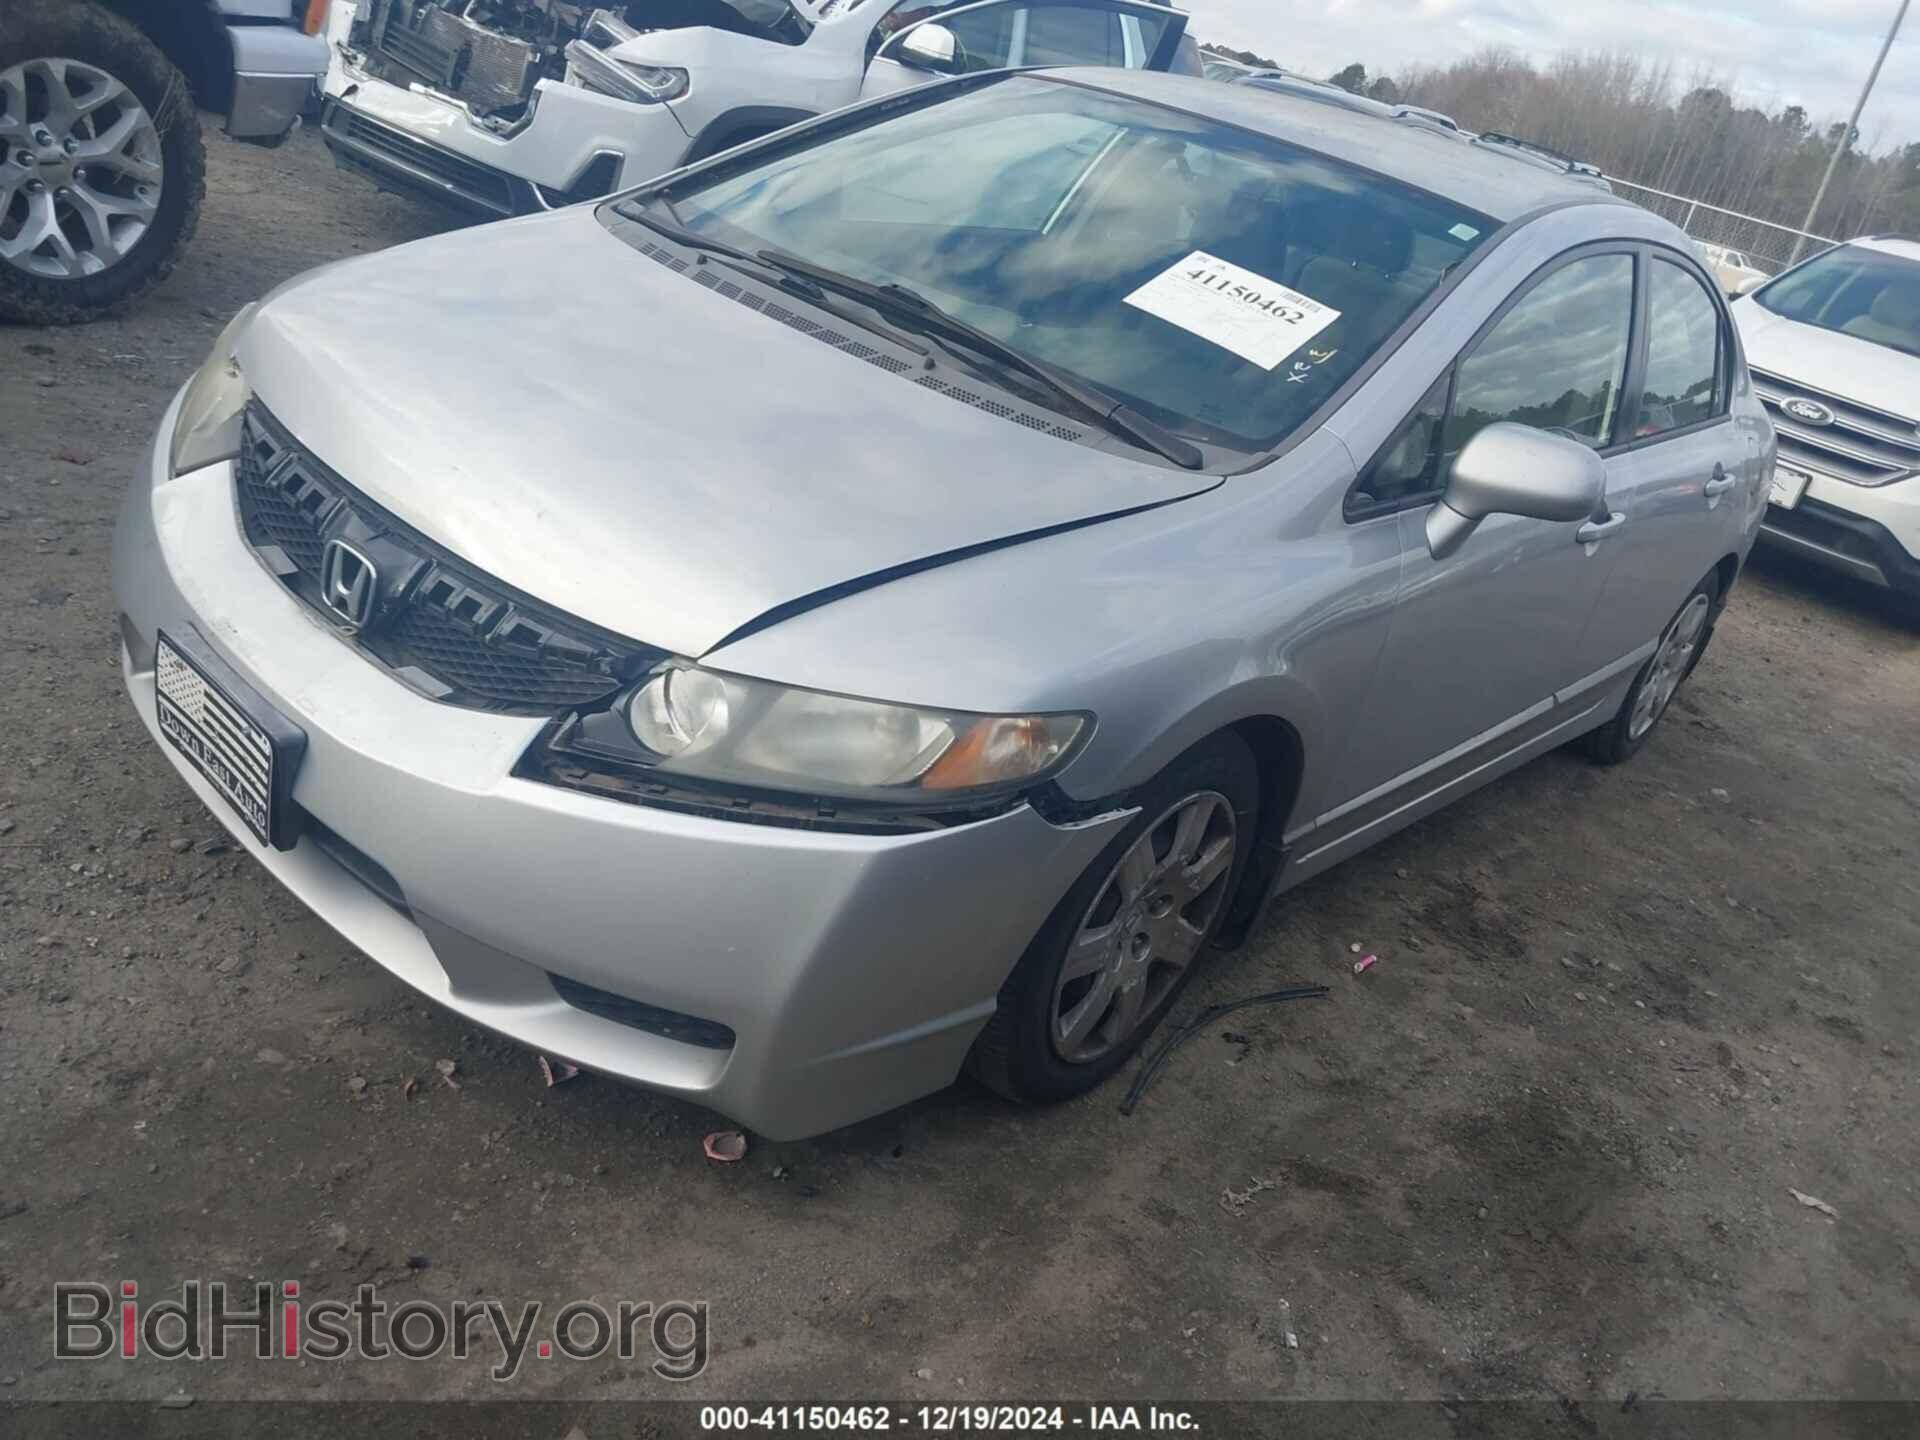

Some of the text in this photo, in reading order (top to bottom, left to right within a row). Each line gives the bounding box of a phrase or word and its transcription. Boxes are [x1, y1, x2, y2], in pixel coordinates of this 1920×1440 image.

[1186, 269, 1305, 325] 41150462
[1790, 402, 1823, 420] Ford
[159, 705, 266, 827] Down East Auto
